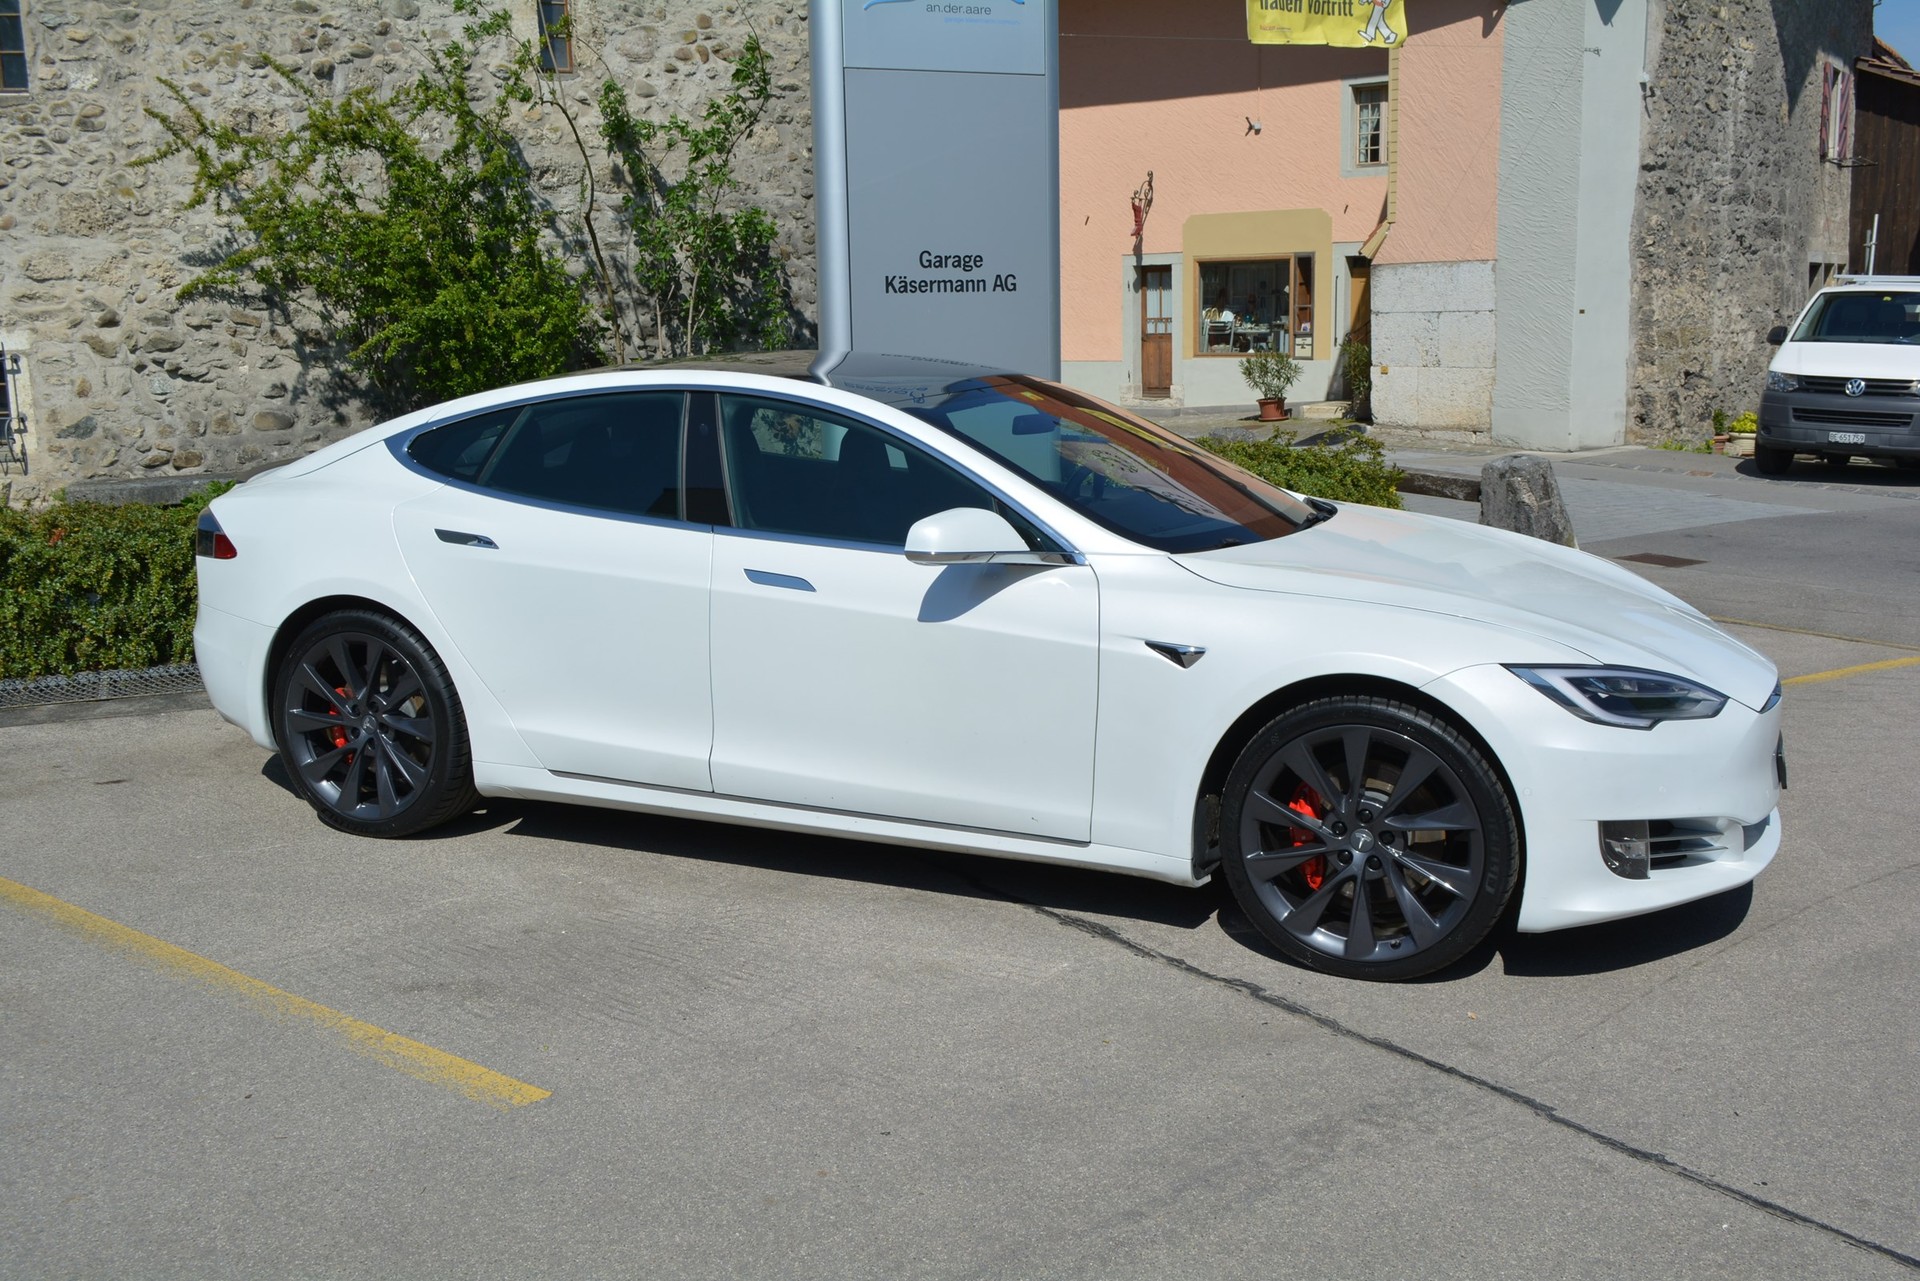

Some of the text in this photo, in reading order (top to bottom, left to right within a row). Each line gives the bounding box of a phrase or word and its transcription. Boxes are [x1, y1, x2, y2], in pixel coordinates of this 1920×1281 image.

[926, 3, 992, 15] an.der.aare
[919, 250, 984, 272] Garage
[885, 274, 1017, 294] Käsermann AG
